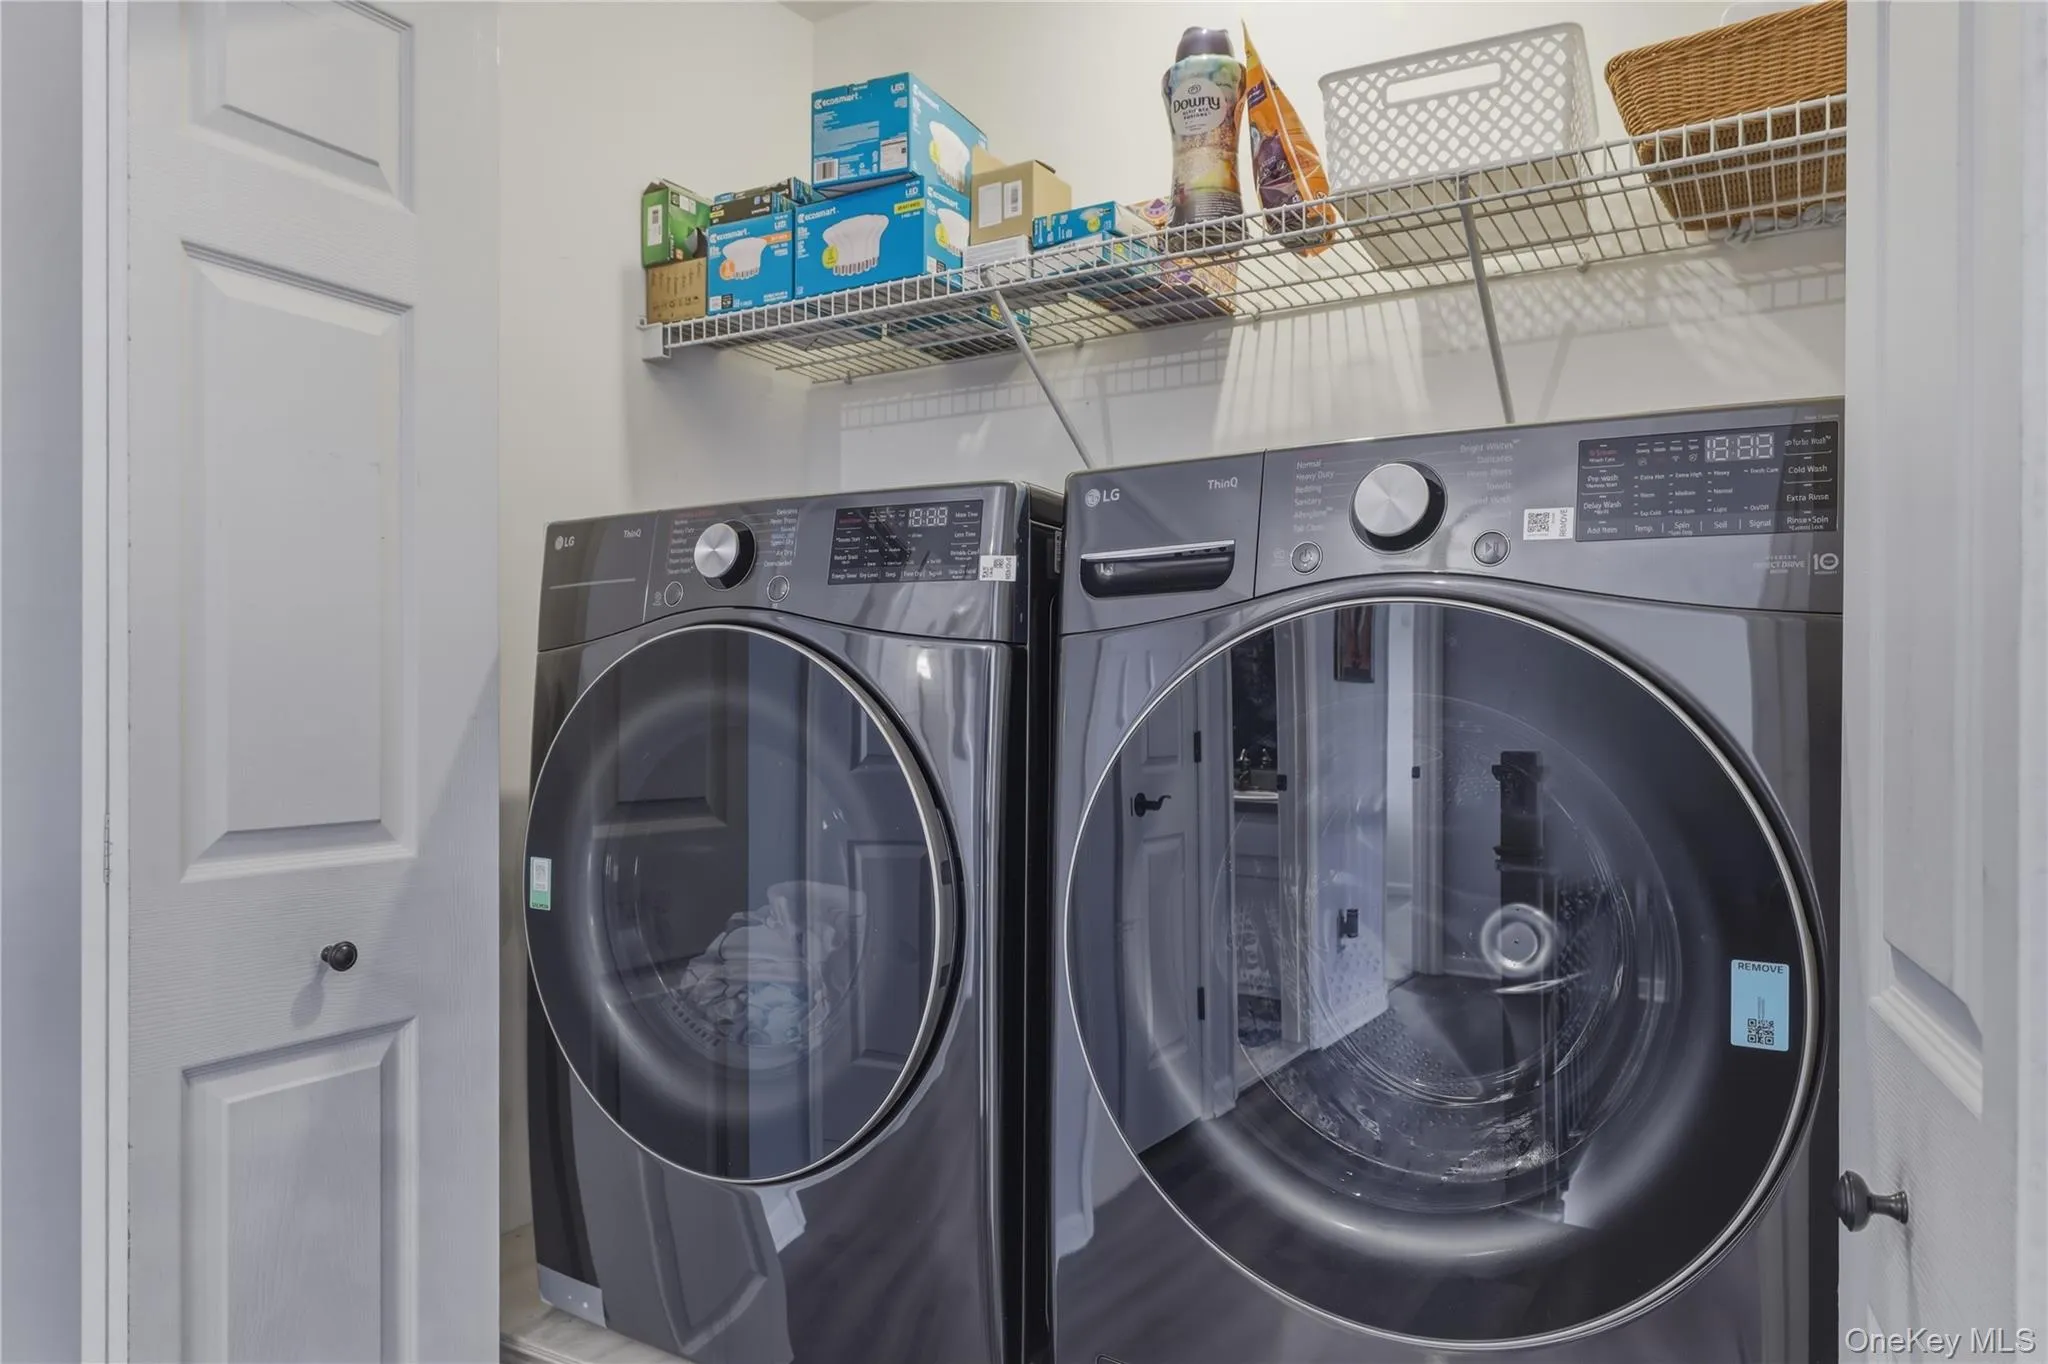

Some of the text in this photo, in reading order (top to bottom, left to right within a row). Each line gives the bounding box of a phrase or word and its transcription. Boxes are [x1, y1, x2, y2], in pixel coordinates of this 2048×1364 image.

[891, 83, 906, 93] LED
[823, 92, 860, 107] ecosmart
[1173, 96, 1220, 114] Downy
[905, 188, 919, 198] LED
[805, 206, 837, 221] ecosmart
[1788, 464, 1828, 474] Cold Wash
[1600, 473, 1618, 482] Wash
[1207, 477, 1239, 490] ThinQ
[1786, 493, 1829, 502] Extra Rinse
[1602, 500, 1622, 509] Wash
[1559, 508, 1568, 537] REMOVE
[1674, 521, 1690, 530] Spin
[1713, 520, 1728, 529] Soil
[1749, 519, 1772, 529] Signal
[624, 528, 642, 538] ThinQ
[1587, 527, 1600, 535] Add
[1813, 553, 1839, 570] 10
[1738, 962, 1785, 975] REMOVE
